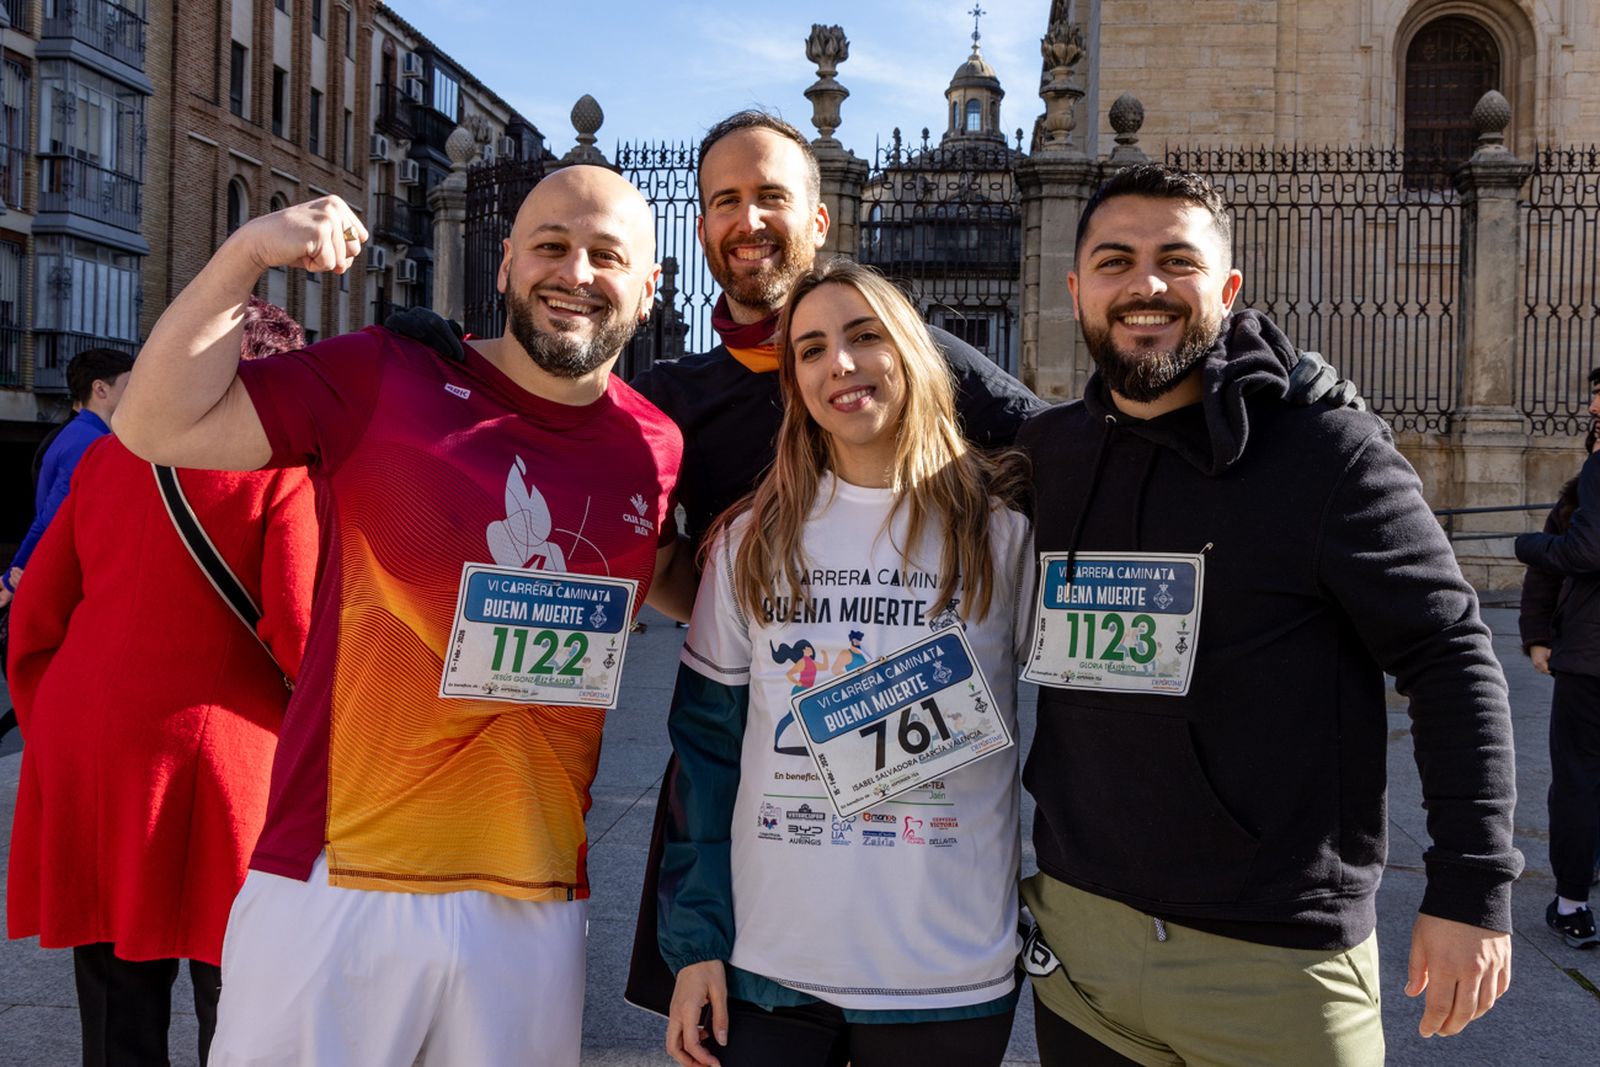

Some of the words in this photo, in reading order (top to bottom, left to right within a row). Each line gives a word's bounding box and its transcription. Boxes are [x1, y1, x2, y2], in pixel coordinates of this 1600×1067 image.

[795, 568, 872, 586] ARRERA
[1073, 566, 1114, 579] ARRERA
[1117, 567, 1175, 581] CAMINATA
[488, 579, 499, 592] VI
[501, 580, 554, 597] CARRERA
[556, 586, 611, 602] CAMINATA
[1056, 585, 1093, 604] BUENA
[1096, 586, 1146, 606] MUERTE
[483, 598, 529, 620] BUENA
[531, 603, 584, 625] MUERTE
[839, 596, 927, 626] MUERTE
[1066, 612, 1157, 664] 1123
[491, 626, 589, 676] 1122
[492, 671, 512, 682] JESÚS
[817, 696, 830, 709] VI
[831, 672, 884, 704] CARRERA
[886, 645, 945, 679] CAMINATA
[1079, 661, 1101, 670] GLORIA
[823, 705, 873, 733] BUENA
[874, 672, 929, 718] MUERTE
[859, 697, 951, 771] 761
[852, 777, 876, 792] ISABEL
[875, 758, 918, 782] SALVADORA
[919, 745, 946, 762] GARCÍA
[948, 729, 983, 749] VALENCIA
[774, 772, 784, 780] En
[786, 772, 820, 782] benefici
[929, 791, 946, 800] Jaén
